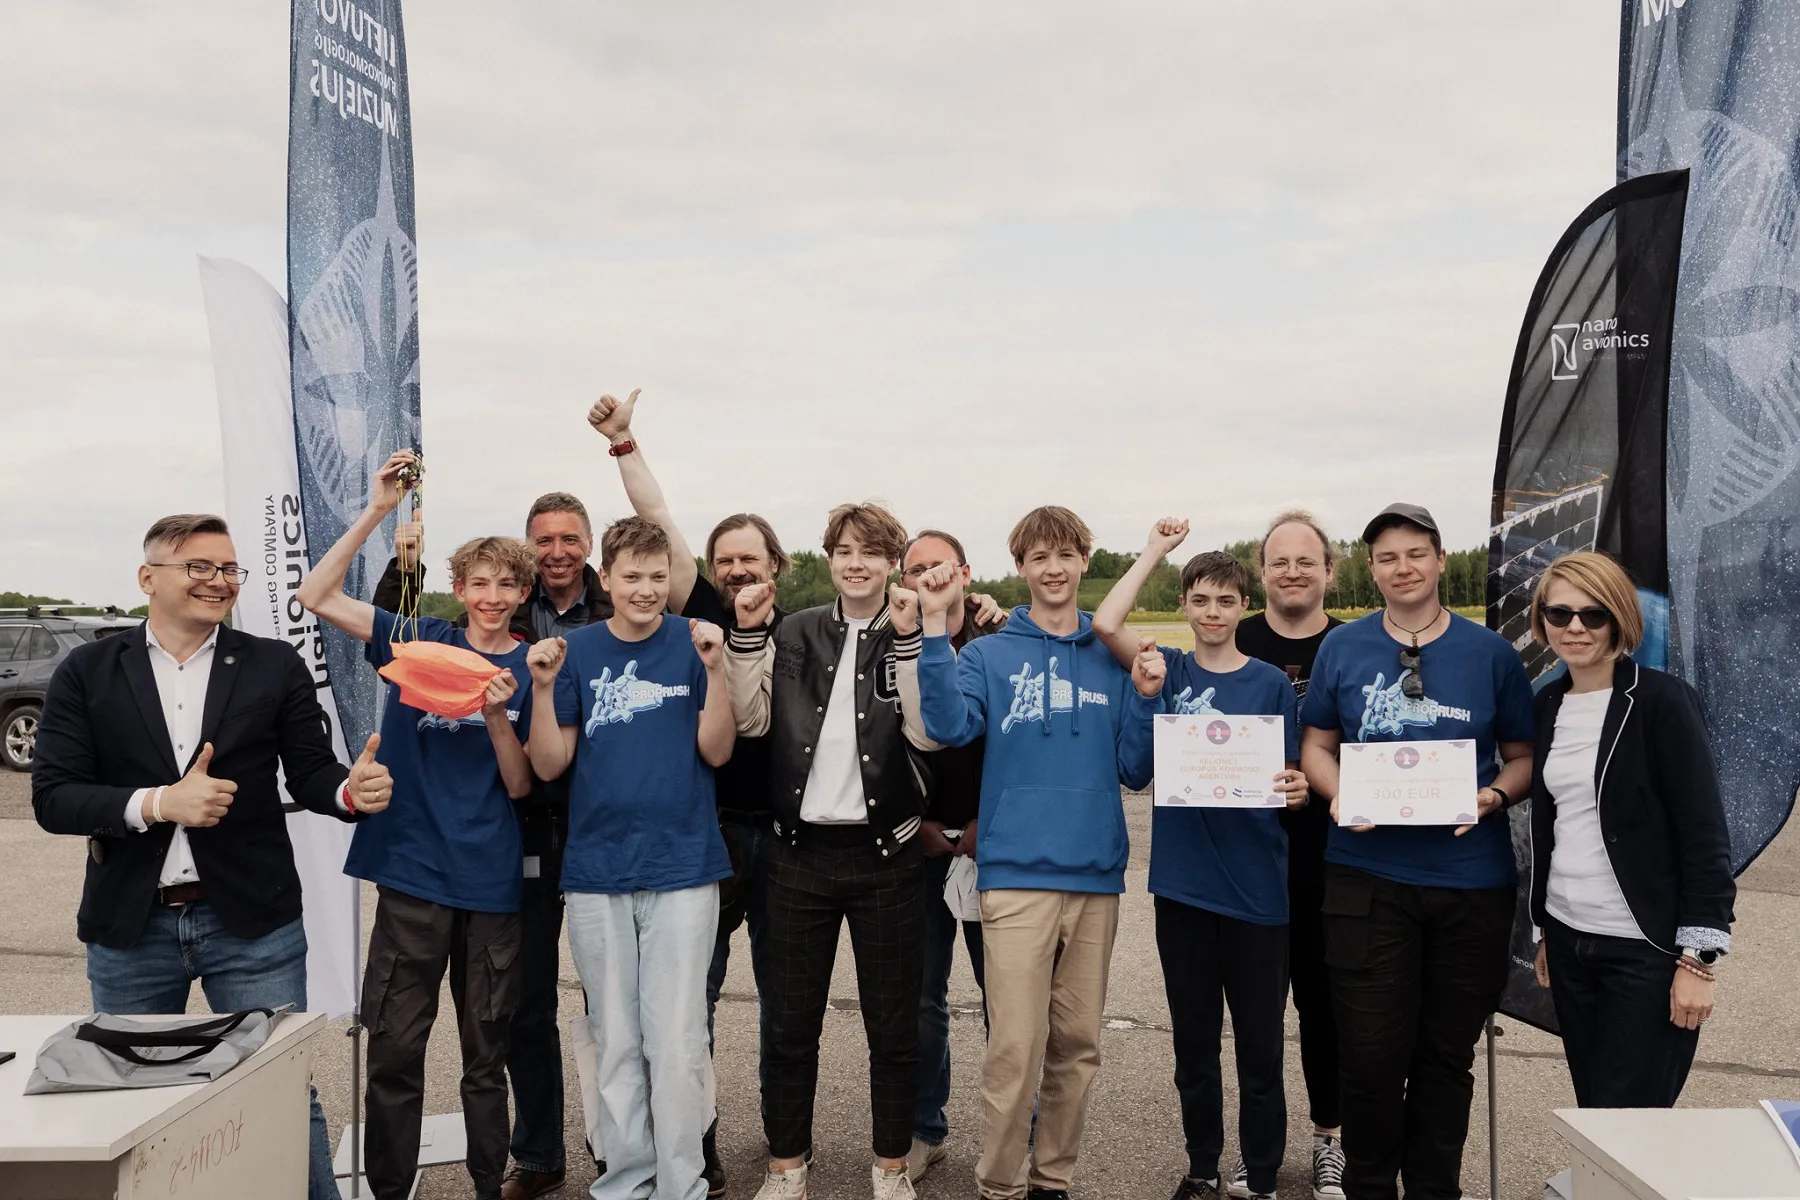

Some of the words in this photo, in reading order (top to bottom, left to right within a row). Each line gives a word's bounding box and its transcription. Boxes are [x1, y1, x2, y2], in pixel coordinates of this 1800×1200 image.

[1582, 330, 1650, 351] avionics
[631, 685, 690, 700] PROPRUSH
[1404, 701, 1471, 722] PROPRUSH
[1371, 788, 1402, 800] 300
[1408, 787, 1441, 800] EUR
